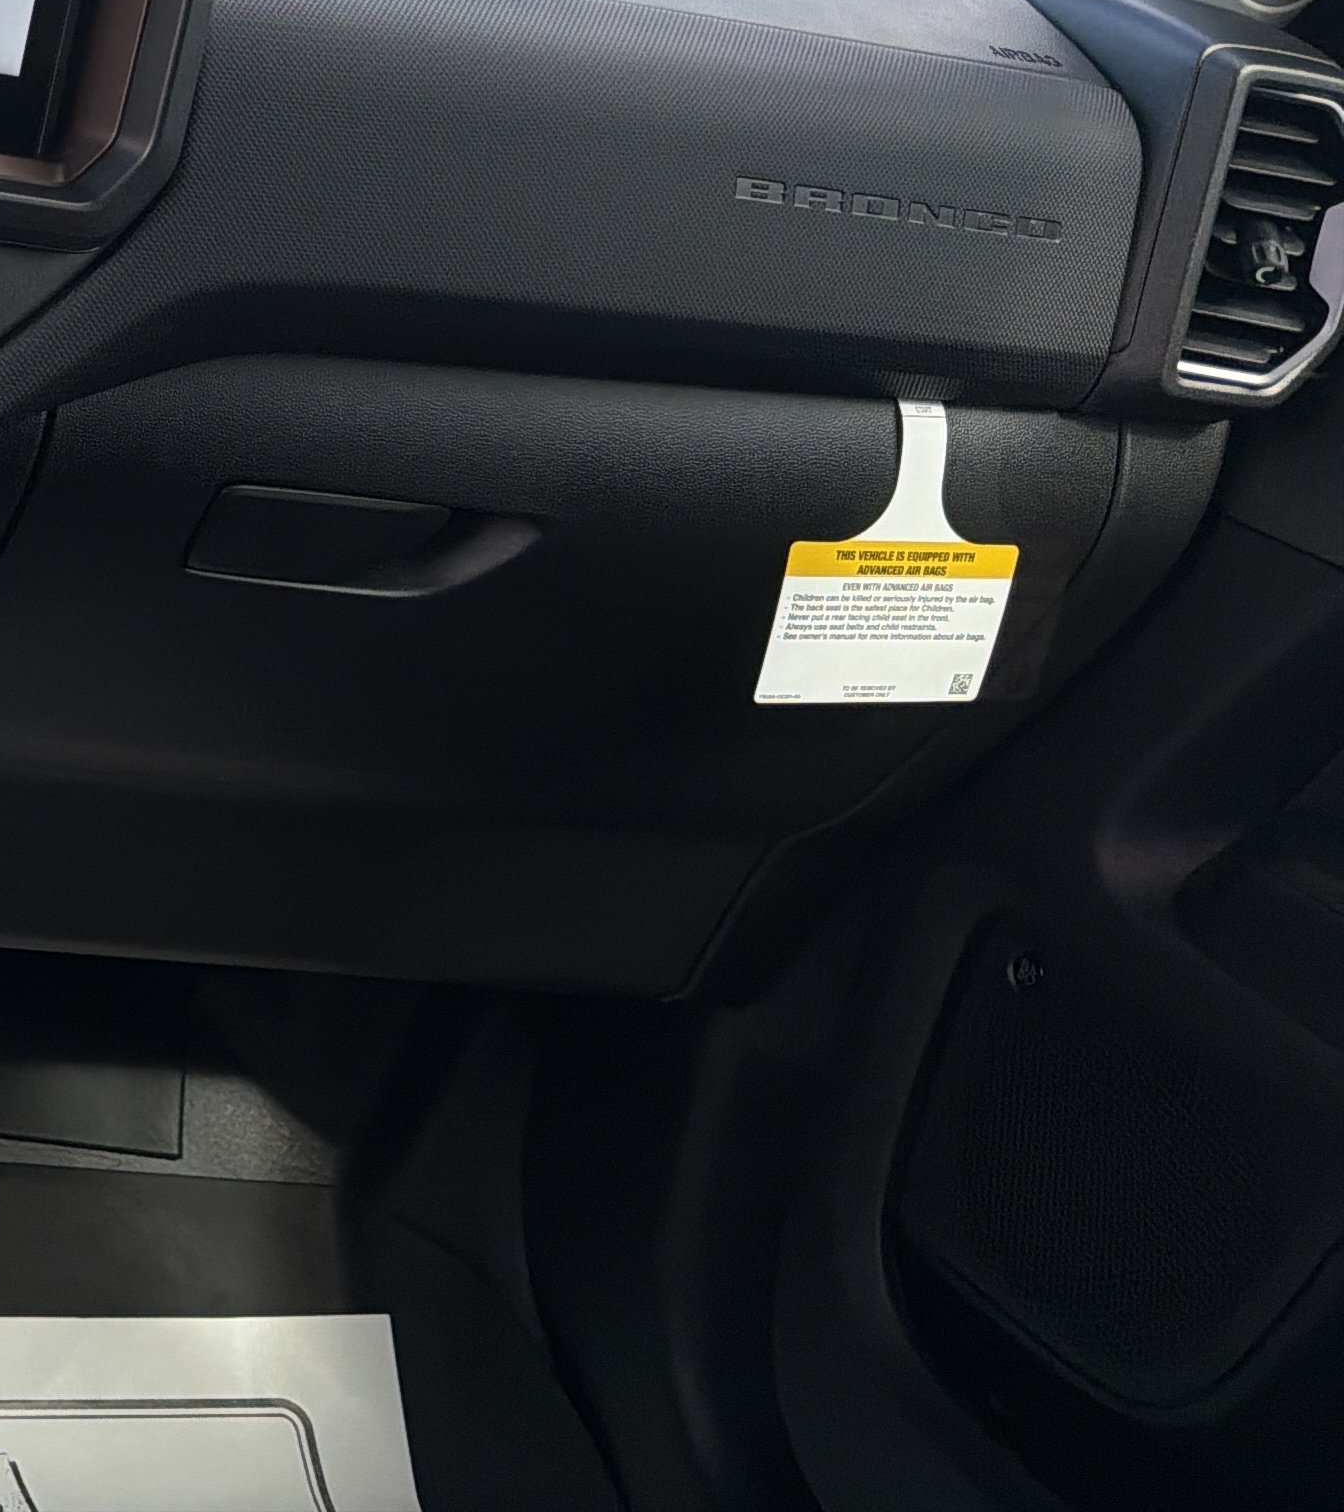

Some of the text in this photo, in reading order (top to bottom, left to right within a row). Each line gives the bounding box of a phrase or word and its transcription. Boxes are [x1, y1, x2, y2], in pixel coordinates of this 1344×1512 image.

[735, 175, 1063, 243] BRONCO
[836, 550, 976, 562] THIS VEHICLE IS EQUIPPED WITH
[856, 565, 947, 576] ADVANCED AIR BAGS
[842, 583, 861, 591] EVEN
[863, 583, 882, 591] WITH
[882, 583, 919, 591] ADVANCED
